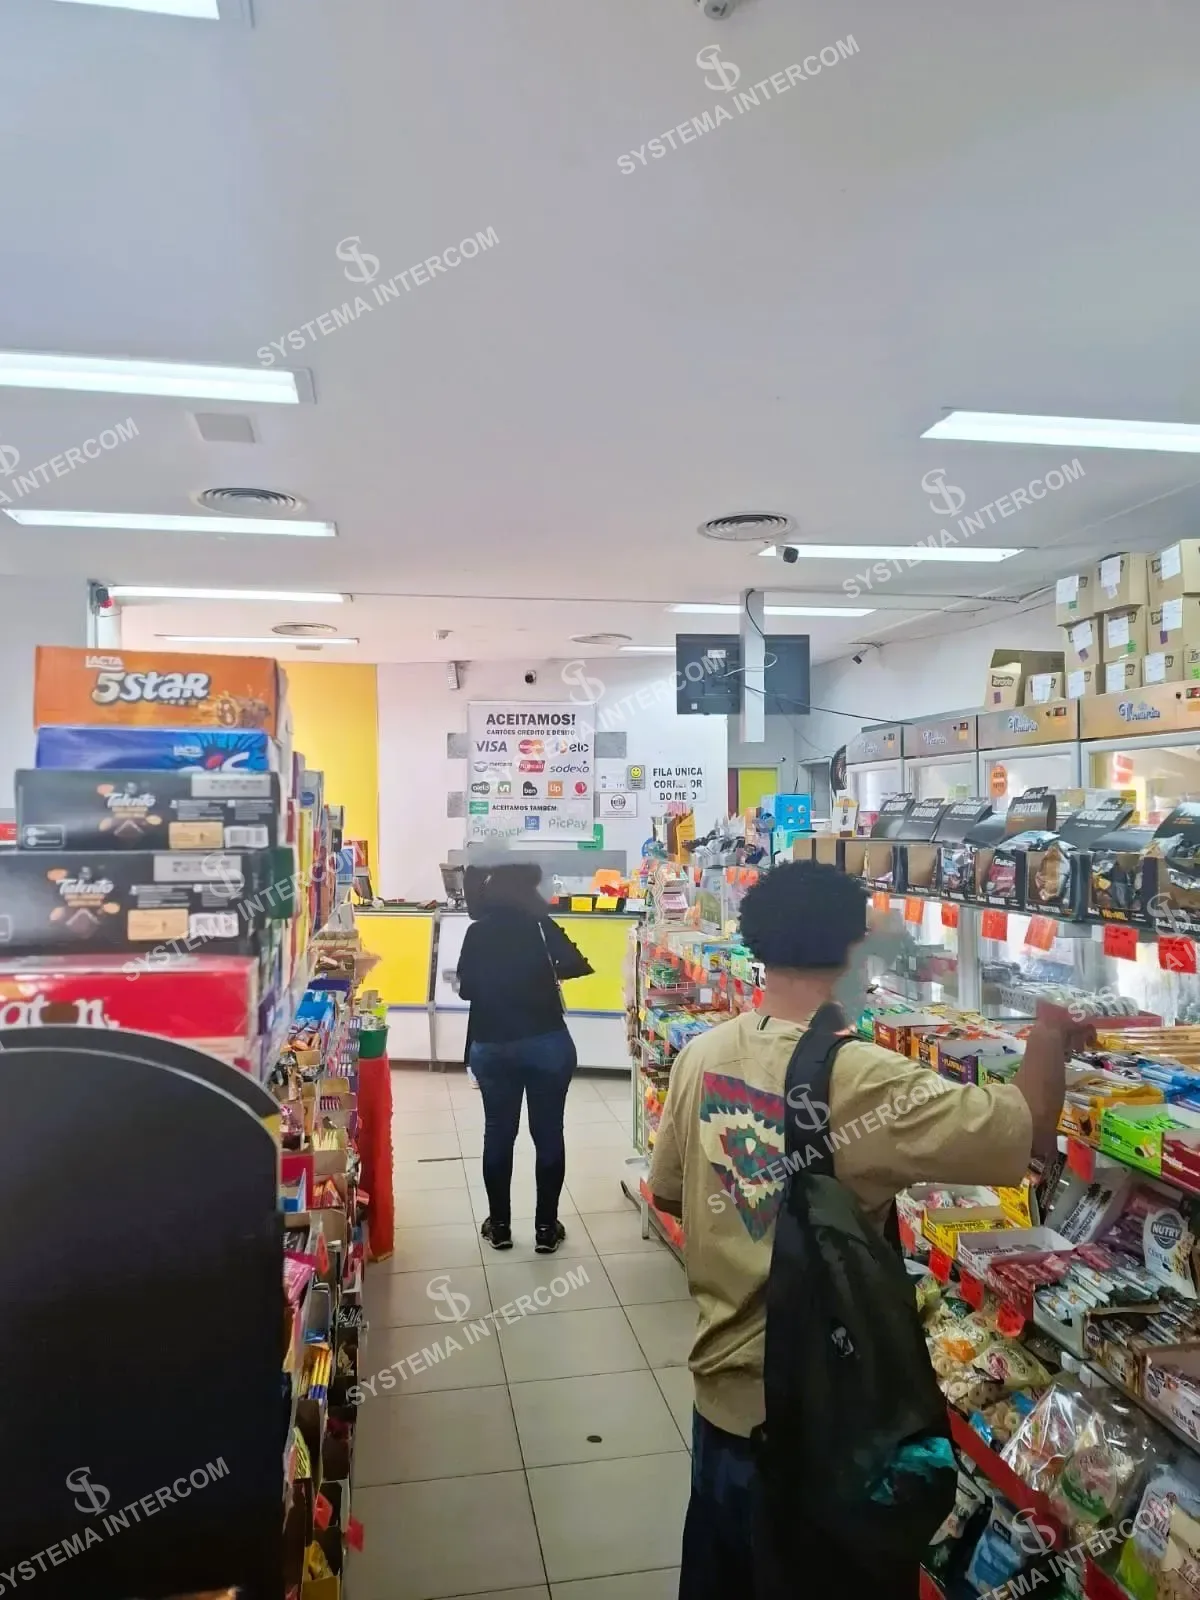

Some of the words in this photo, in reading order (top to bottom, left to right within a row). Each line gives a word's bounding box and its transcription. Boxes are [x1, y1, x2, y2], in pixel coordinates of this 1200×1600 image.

[85, 656, 124, 670] LACTA
[486, 713, 577, 726] ACEITAMOS!
[476, 740, 508, 752] VISA
[549, 760, 590, 773] sodexo
[653, 768, 672, 776] FILA
[660, 792, 672, 801] DO
[549, 817, 587, 830] PicPay
[1153, 1223, 1179, 1237] NUTRY
